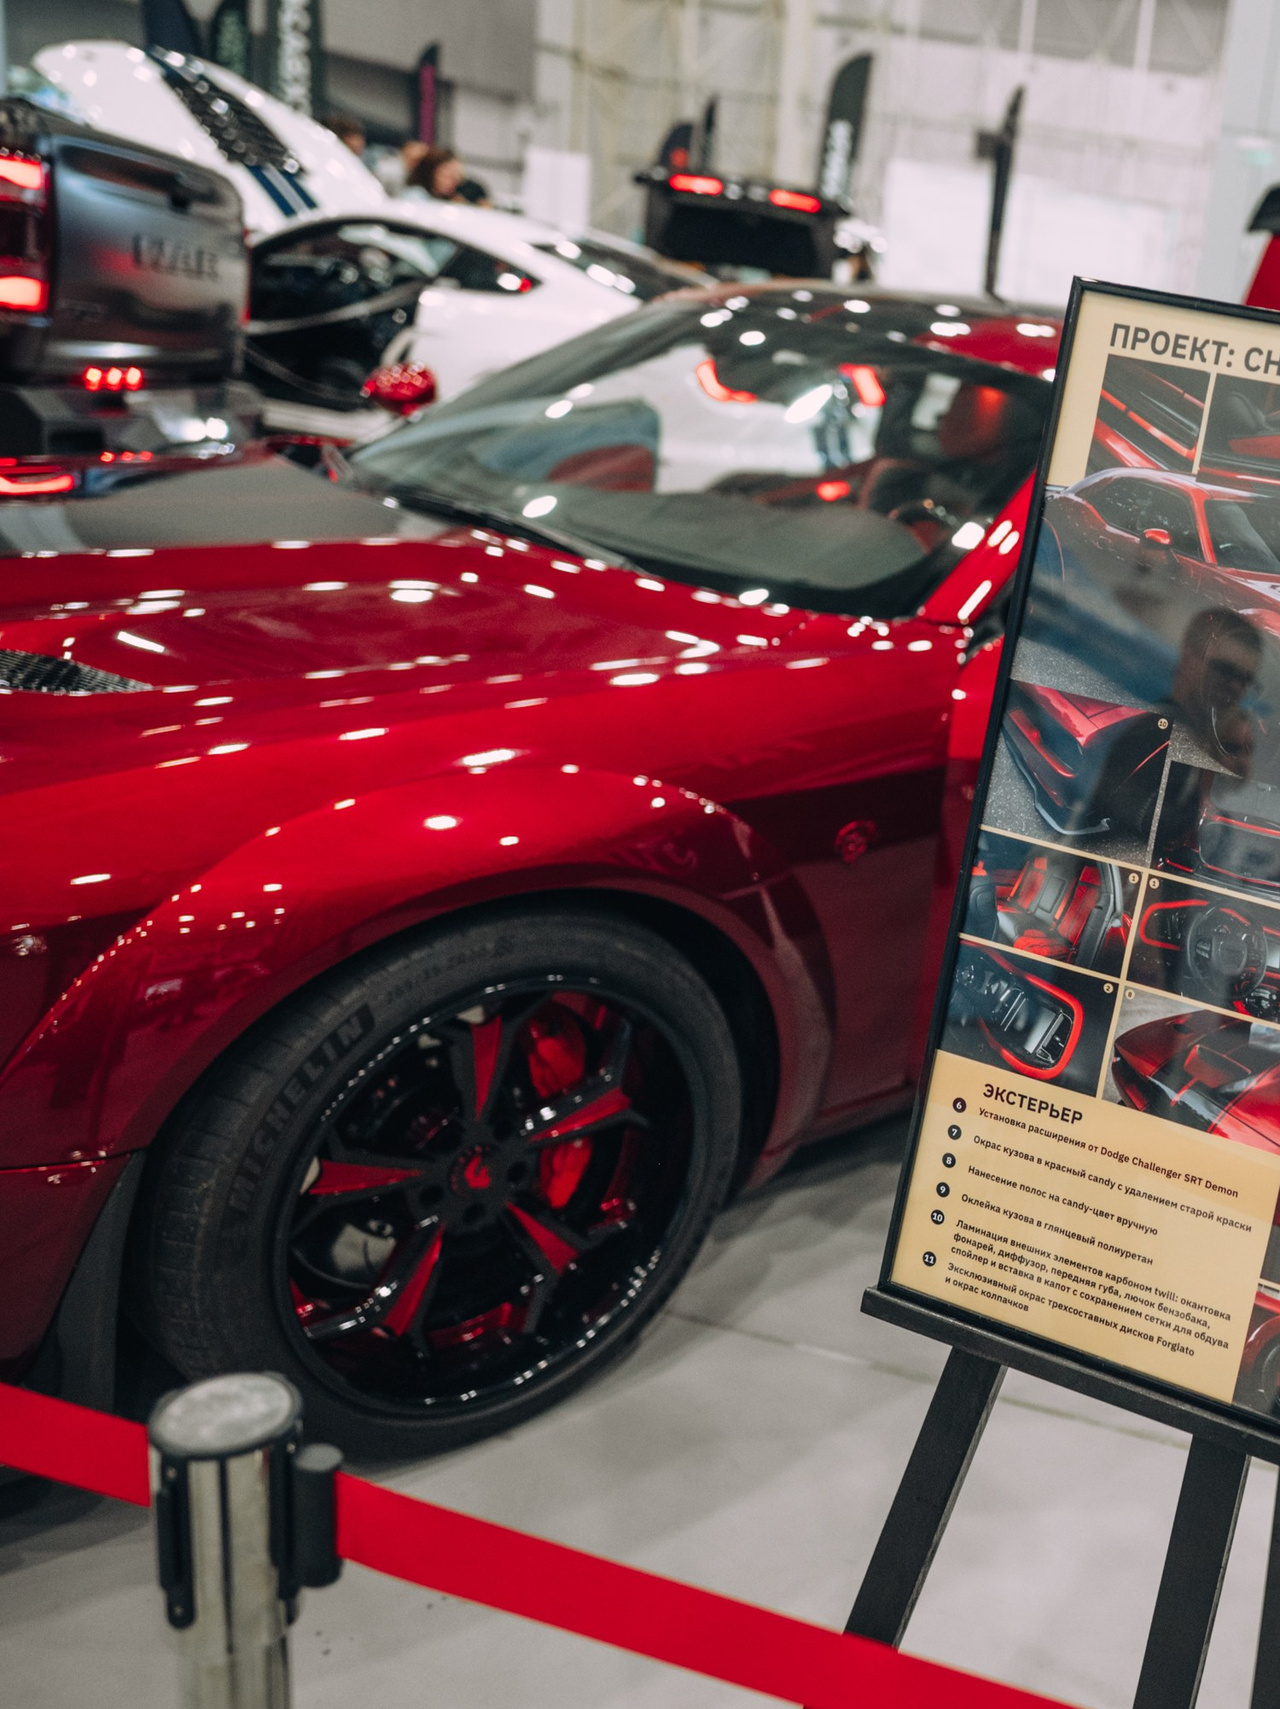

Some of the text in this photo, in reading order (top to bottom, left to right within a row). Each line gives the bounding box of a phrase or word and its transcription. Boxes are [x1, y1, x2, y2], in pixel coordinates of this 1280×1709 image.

[1109, 322, 1235, 368] ПРОЕКТ:
[228, 1016, 366, 1212] MICHELIN
[982, 1083, 1083, 1125] ЭКСТЕРЬЕР
[973, 1134, 1002, 1151] Окрас
[1002, 1146, 1035, 1163] кузова
[1036, 1157, 1043, 1165] в
[1043, 1159, 1086, 1179] красный
[1087, 1173, 1116, 1190] candy
[1116, 1183, 1123, 1191] с
[1123, 1185, 1178, 1209] удалением
[1179, 1204, 1214, 1221] старой
[1215, 1215, 1252, 1233] краски
[978, 1107, 1026, 1130] Установка
[1027, 1124, 1086, 1149] расширения
[1087, 1144, 1099, 1153] от
[1100, 1146, 1130, 1164] Dodge
[1131, 1156, 1182, 1180] Challenger
[1183, 1173, 1203, 1186] SRT
[1204, 1179, 1239, 1198] Demon
[961, 1193, 1001, 1214] Оклейка
[1002, 1208, 1035, 1225] кузова
[1035, 1219, 1042, 1228] в
[1043, 1222, 1096, 1246] глянцевый
[1096, 1240, 1153, 1266] полиуретан
[967, 1164, 1018, 1189] Нанесение
[1019, 1183, 1047, 1198] полос
[1048, 1193, 1060, 1203] на
[1061, 1197, 1115, 1220] candy-цвет
[1116, 1215, 1158, 1236] вручную
[944, 1276, 1029, 1312] и окрас колпачков
[947, 1262, 1017, 1294] Эксклюзивный
[1018, 1289, 1046, 1304] окрас
[1047, 1298, 1119, 1330] трехсоставных
[1118, 1324, 1155, 1343] дисков
[950, 1246, 1229, 1349] спойлер и вставка в капот с сохранением сетки для обдува
[953, 1232, 1210, 1330] фонарей, диффузор, передняя губа, лючок бензобака,
[955, 1219, 1009, 1244] Ламинация
[1009, 1239, 1052, 1259] внешних
[1052, 1254, 1103, 1277] элементов
[1104, 1272, 1152, 1294] карбоном
[1154, 1287, 1179, 1303] twill:
[1180, 1297, 1231, 1322] окантовка
